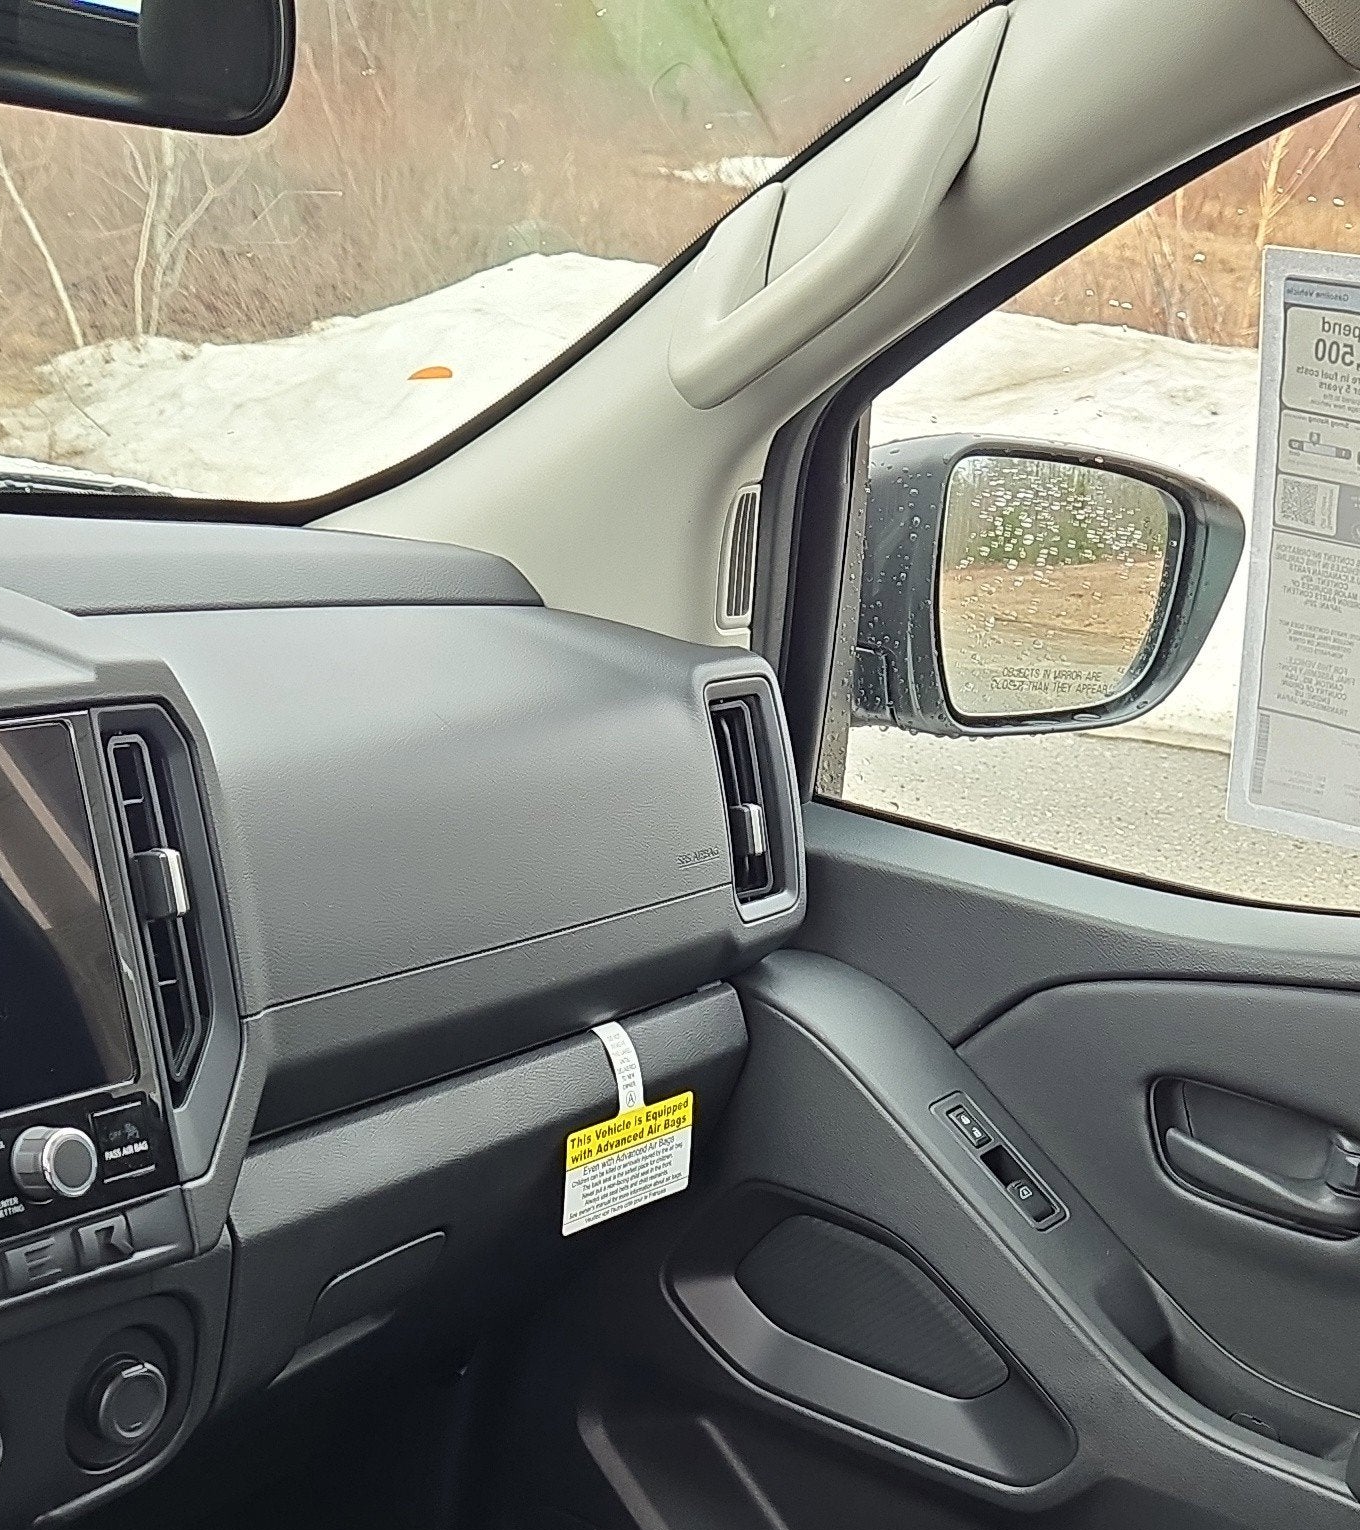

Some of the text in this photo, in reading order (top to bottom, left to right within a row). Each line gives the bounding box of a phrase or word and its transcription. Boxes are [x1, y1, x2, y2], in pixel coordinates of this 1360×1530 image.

[1003, 668, 1040, 678] OBJECTS
[1054, 669, 1086, 680] MIRROR
[1088, 670, 1102, 681] ARE
[1028, 680, 1109, 694] THAN THEY APPEAR
[569, 1096, 689, 1151] This Vehicle is Equipped
[570, 1111, 687, 1165] with Advanced Air Bags
[104, 1141, 149, 1161] PASS AIR BAG
[582, 1133, 674, 1176] Even with Advanced Air Bags
